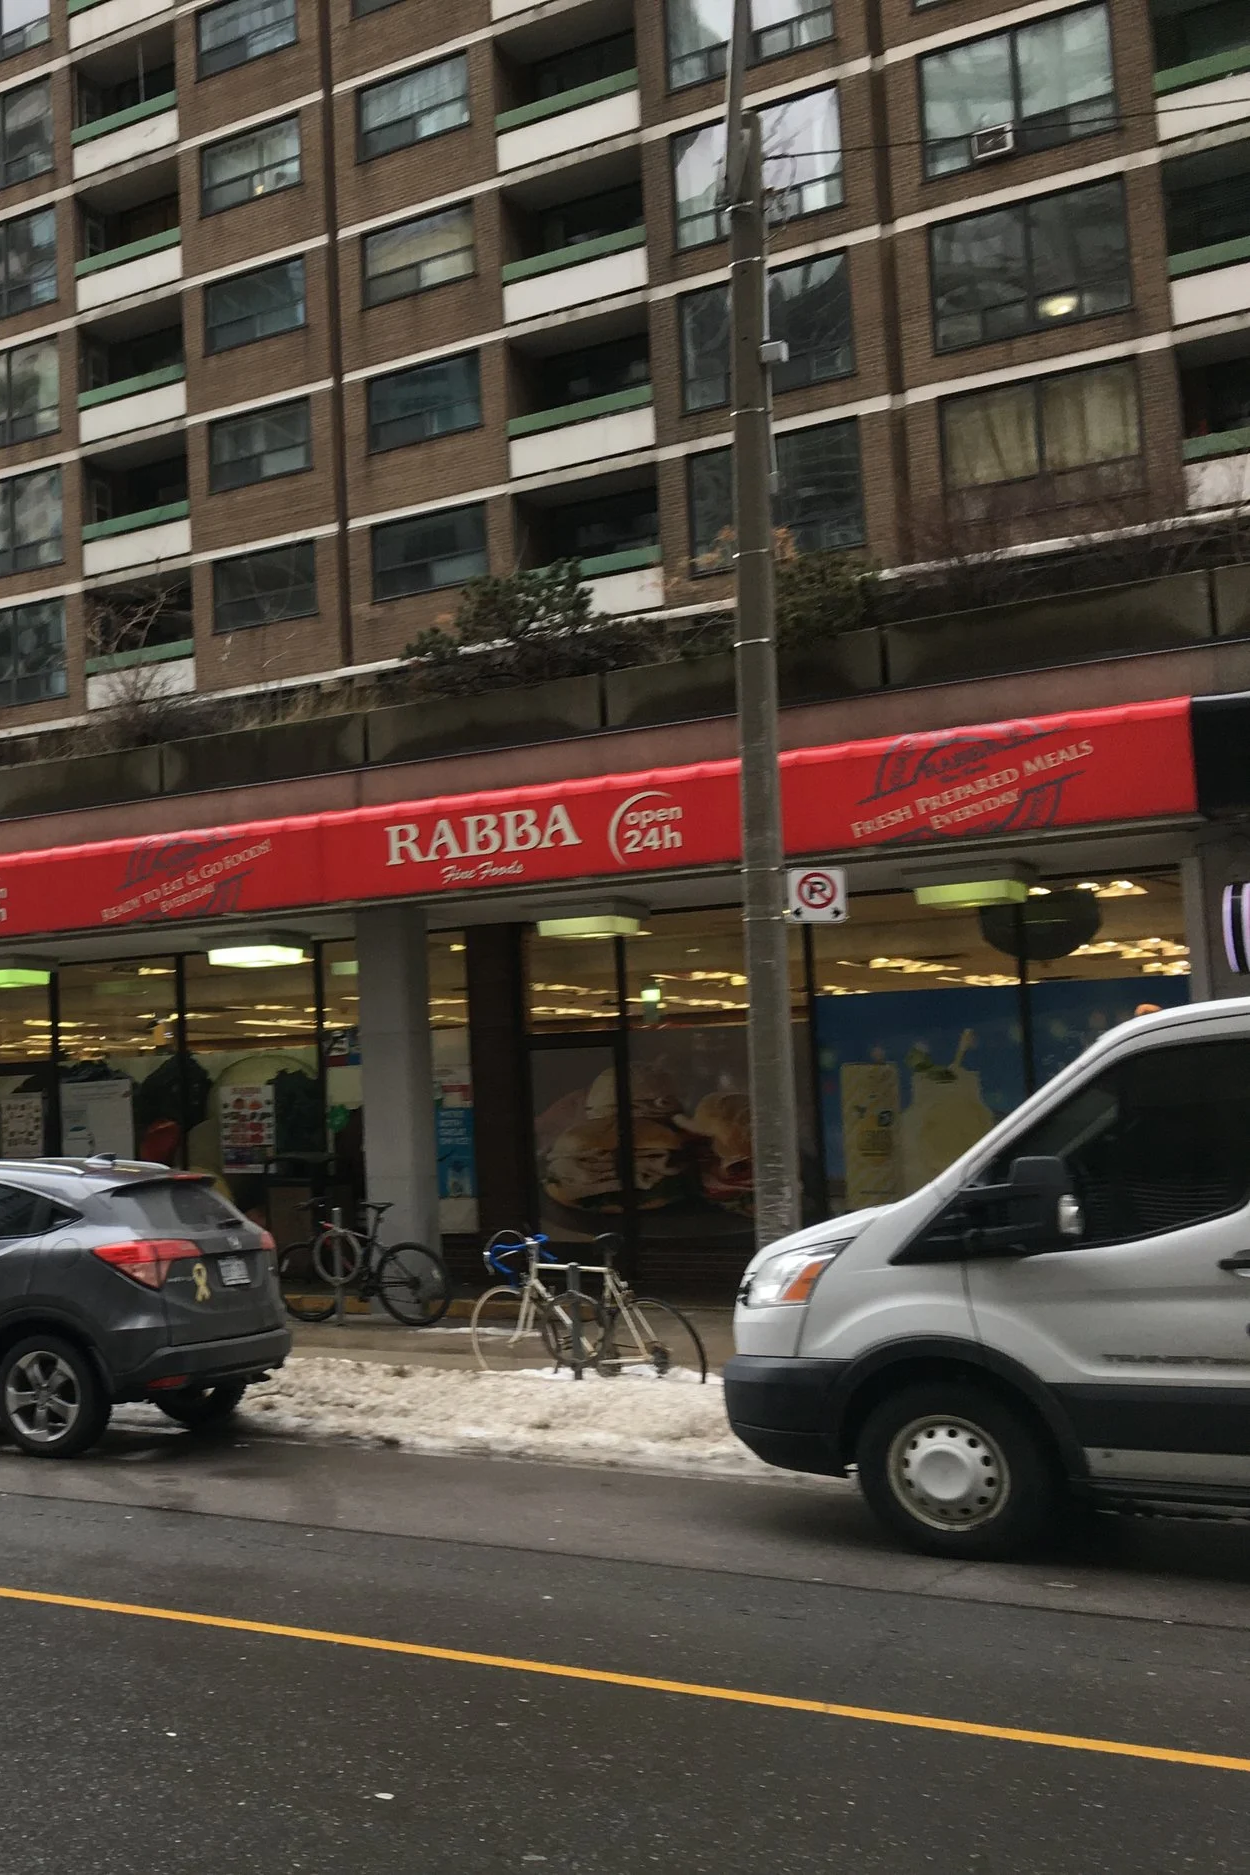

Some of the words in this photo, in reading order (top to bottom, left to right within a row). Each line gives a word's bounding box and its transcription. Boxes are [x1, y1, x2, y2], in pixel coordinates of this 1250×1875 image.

[850, 805, 914, 839] FRESH
[915, 768, 1020, 815] PREPARED
[1021, 739, 1095, 777] MEALS
[624, 805, 683, 829] open
[929, 788, 1020, 830] EVERYDAY
[383, 803, 583, 866] RABBA
[623, 824, 683, 854] 24h
[185, 869, 200, 886] &
[439, 864, 476, 885] Fine
[475, 860, 525, 881] Foods
